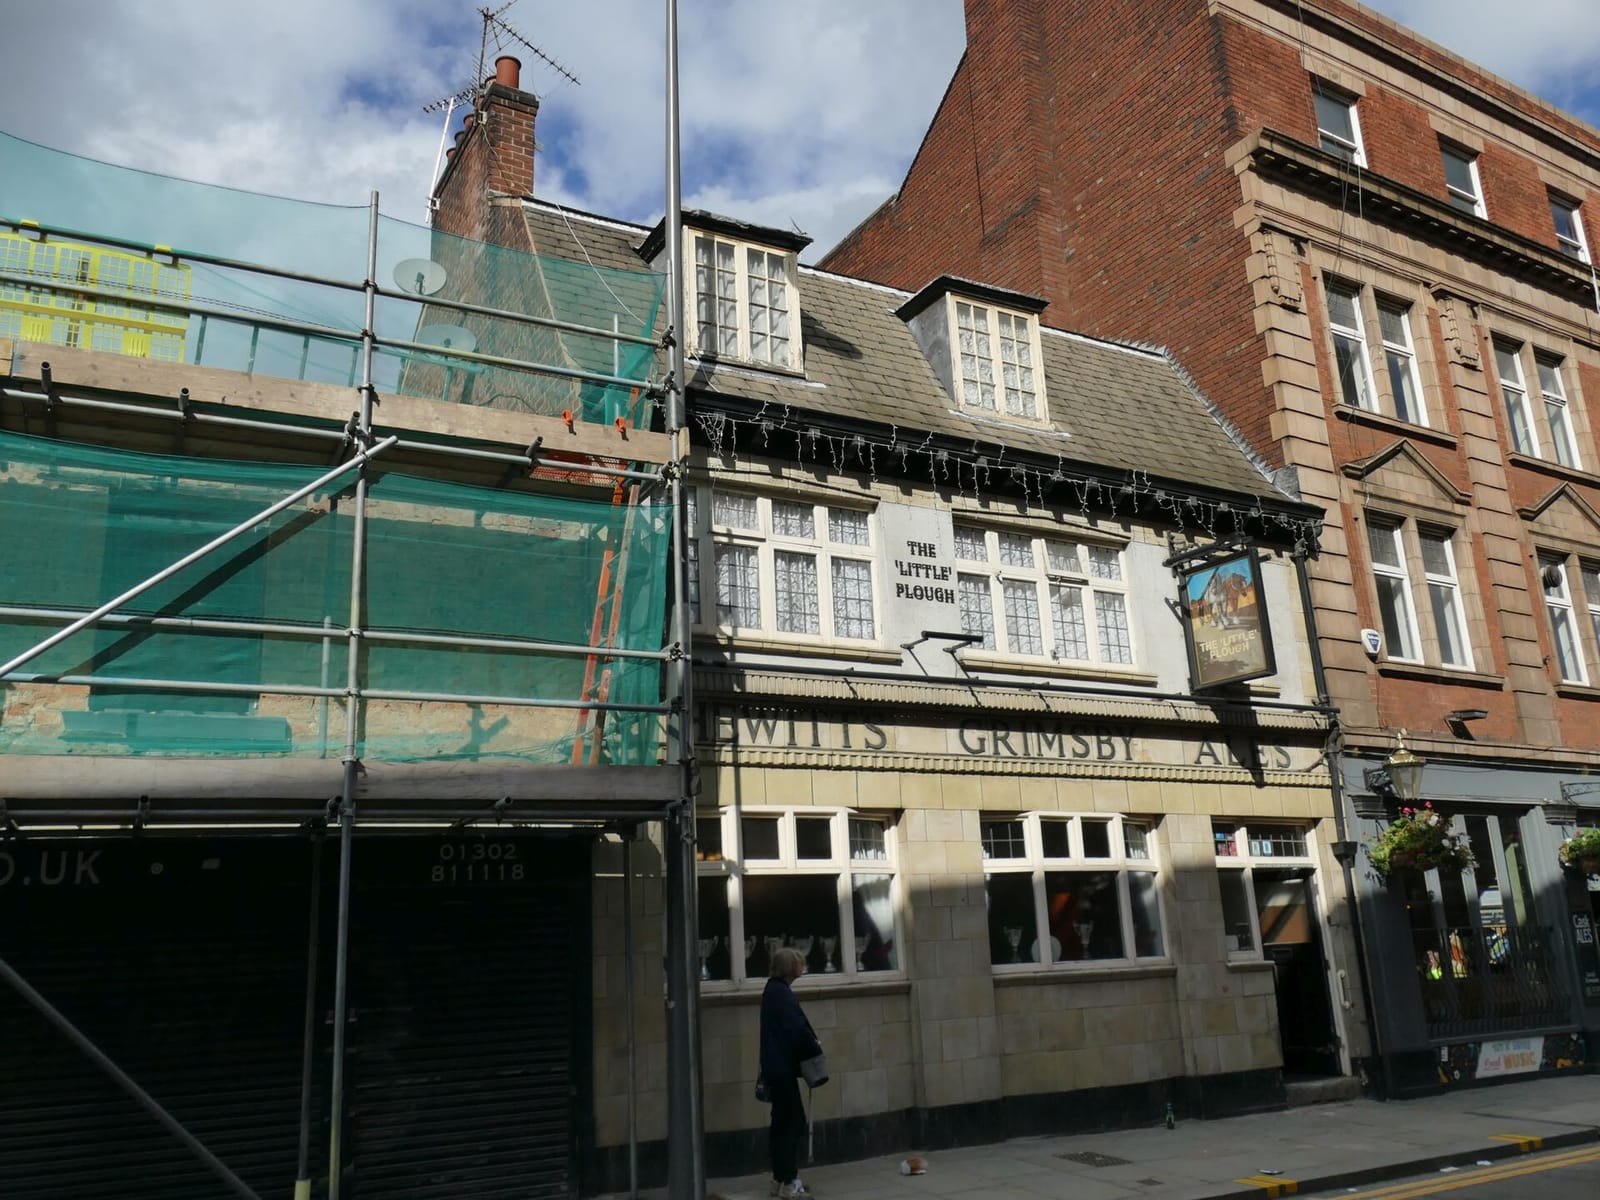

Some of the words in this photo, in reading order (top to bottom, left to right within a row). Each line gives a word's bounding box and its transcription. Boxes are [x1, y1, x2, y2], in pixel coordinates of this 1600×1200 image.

[906, 540, 937, 559] THE
[895, 559, 952, 581] 'LITTLE'
[895, 582, 955, 605] PLOUGH
[1199, 640, 1218, 653] THE
[1210, 641, 1249, 660] PLOUGH
[958, 717, 1136, 762] GRIMSBY
[1193, 734, 1292, 769] ALES
[439, 842, 518, 861] 01302
[431, 863, 527, 883] 811118
